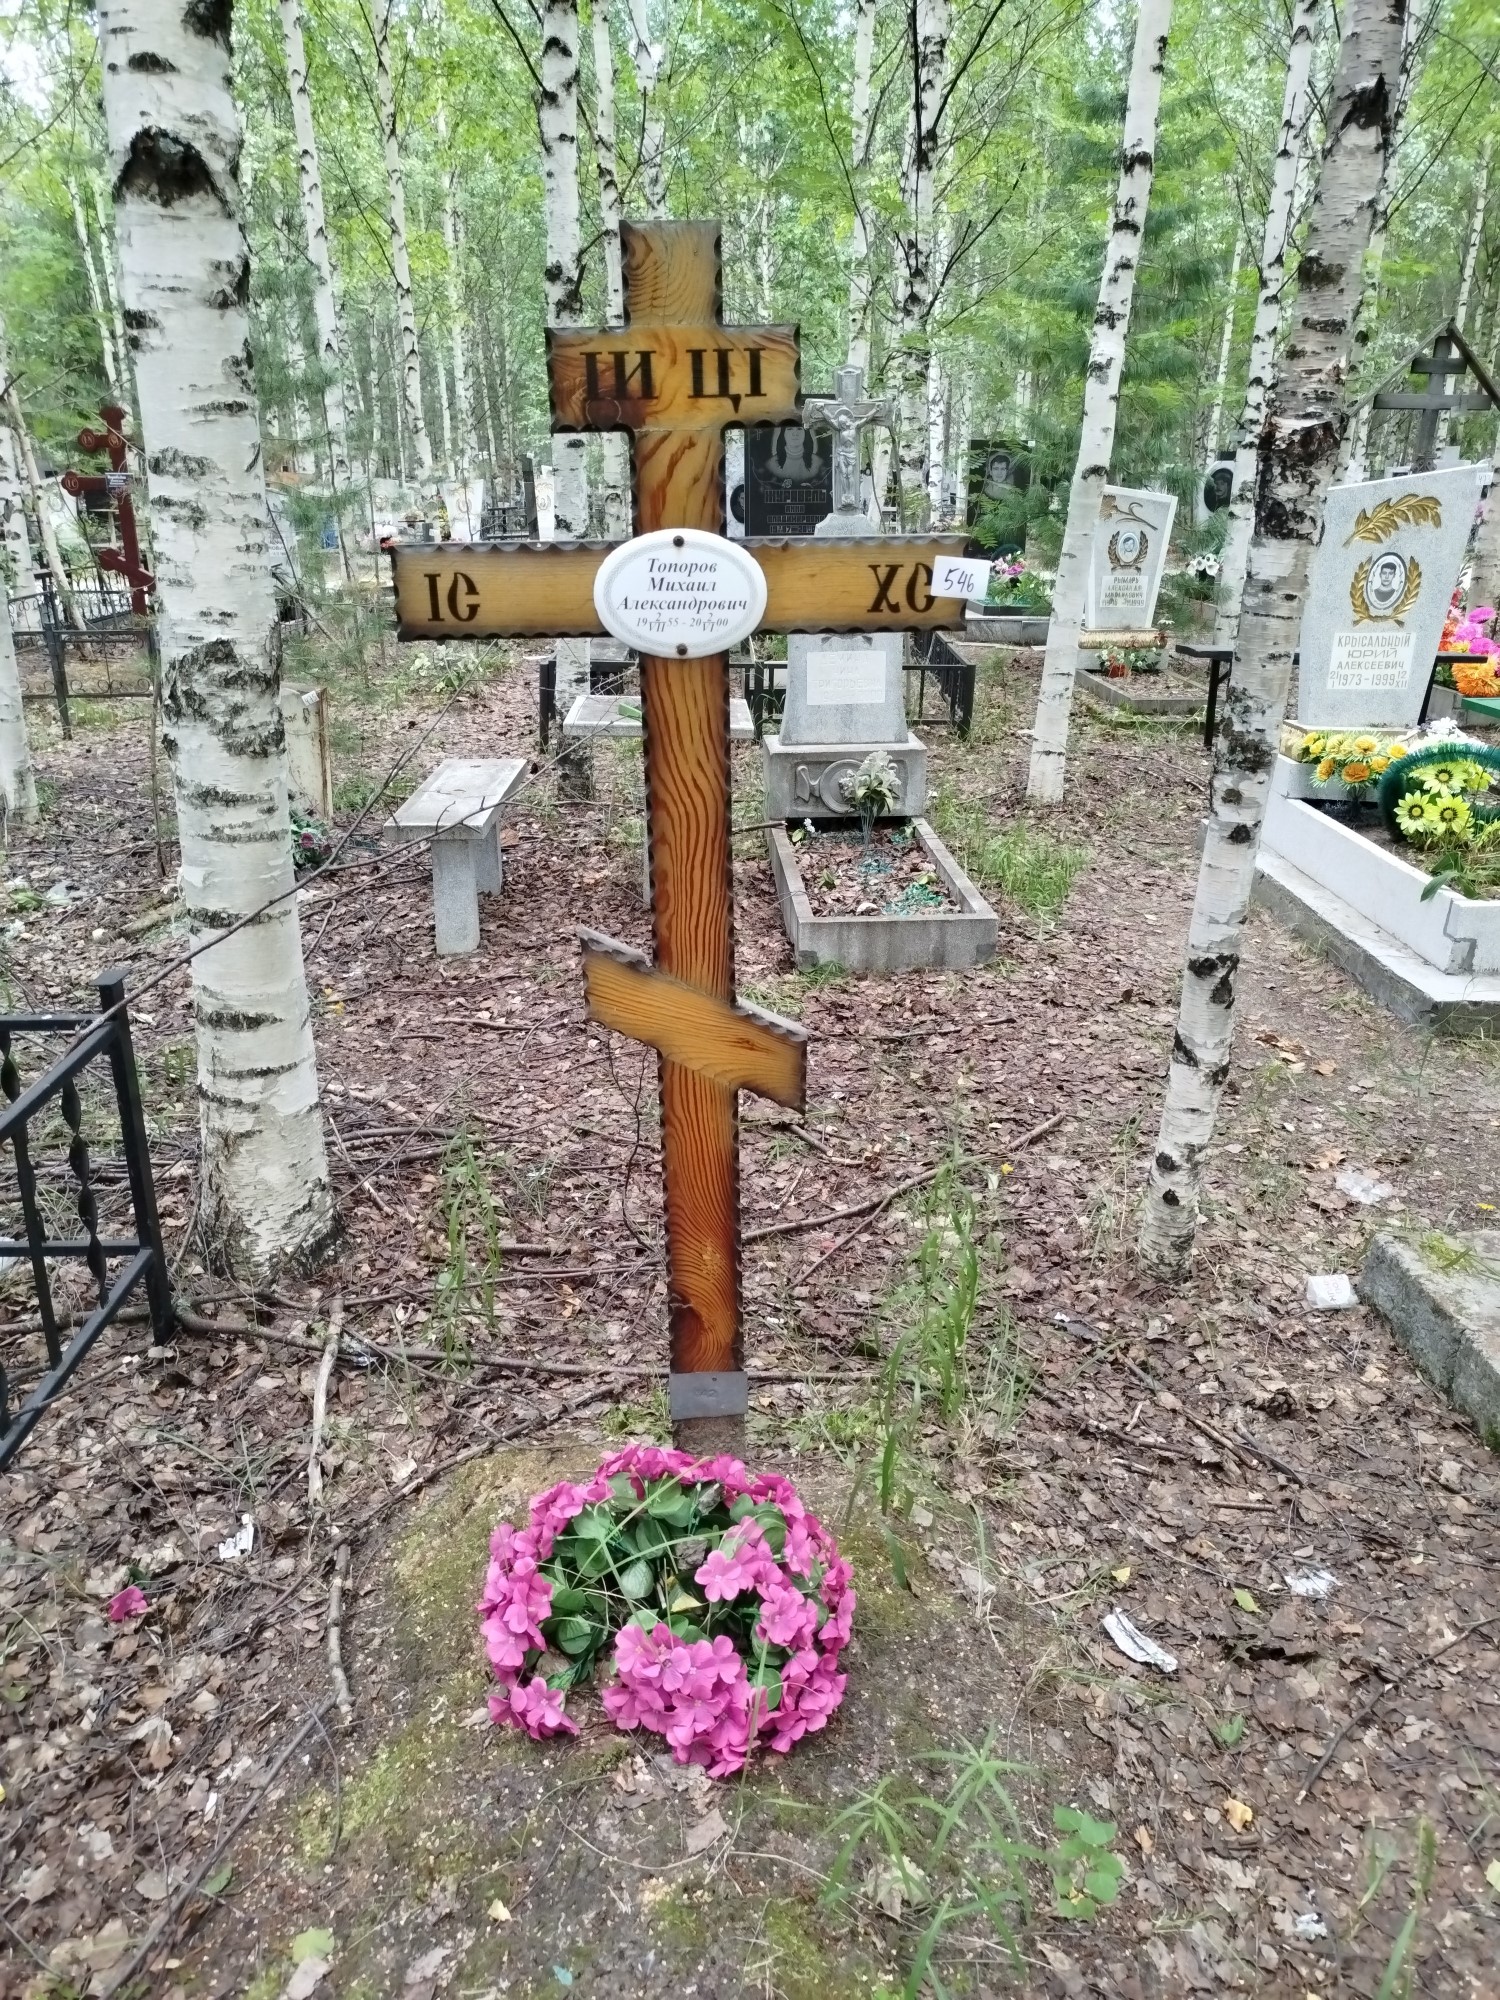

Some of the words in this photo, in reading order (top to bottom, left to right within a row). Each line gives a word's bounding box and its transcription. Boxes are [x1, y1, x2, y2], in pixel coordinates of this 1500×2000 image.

[647, 558, 718, 577] Топоров
[647, 577, 716, 592] Михаил
[944, 568, 975, 593] 546
[616, 596, 748, 615] Александрович
[1337, 632, 1411, 648] КРЫСАЛЬНЫЙ
[1348, 648, 1398, 658] ЮРИЙ
[1337, 661, 1404, 670] АЛЕКСЕЕВИЧ
